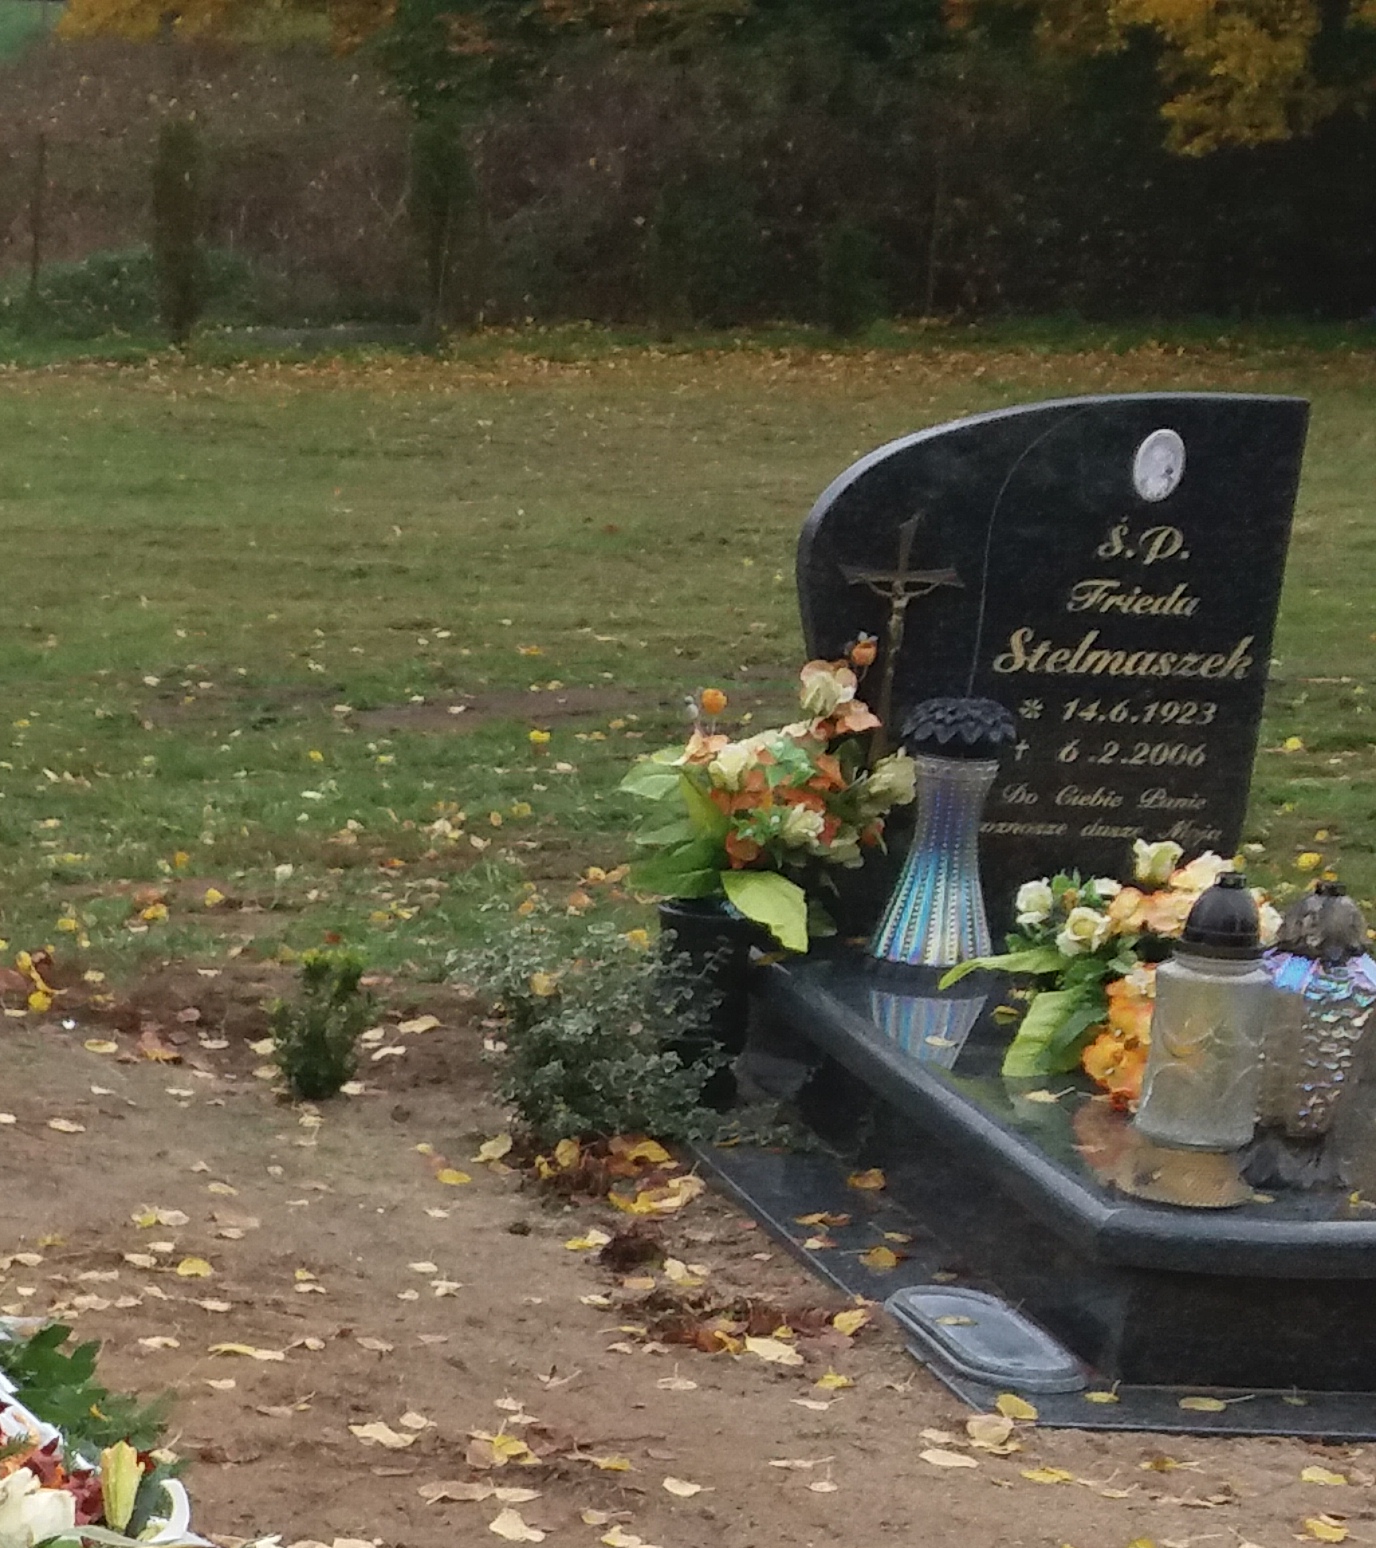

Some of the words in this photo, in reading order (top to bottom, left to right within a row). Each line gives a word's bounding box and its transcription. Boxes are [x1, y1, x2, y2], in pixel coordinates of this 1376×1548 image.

[1066, 577, 1202, 618] Frieda
[992, 625, 1256, 682] Stelmaszek
[1062, 697, 1219, 726] 14.6.1923
